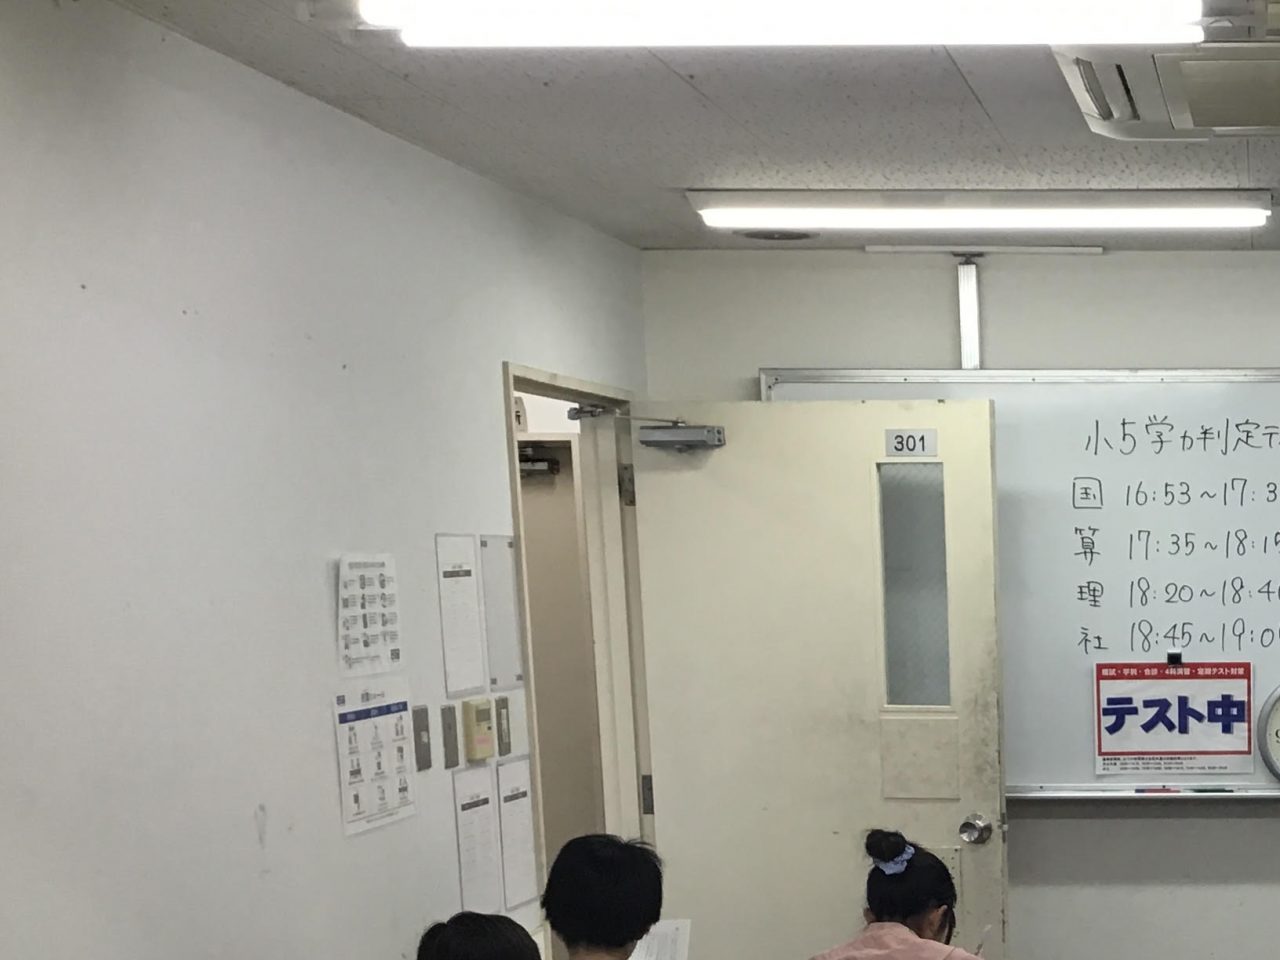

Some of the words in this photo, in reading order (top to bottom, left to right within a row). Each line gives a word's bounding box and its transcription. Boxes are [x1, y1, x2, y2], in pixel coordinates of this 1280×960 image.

[893, 434, 925, 452] 301
[1072, 476, 1104, 510] 国
[1074, 525, 1101, 567] 算
[1077, 580, 1104, 608] 理
[1077, 626, 1109, 655] 社
[1101, 693, 1248, 735] テスト中
